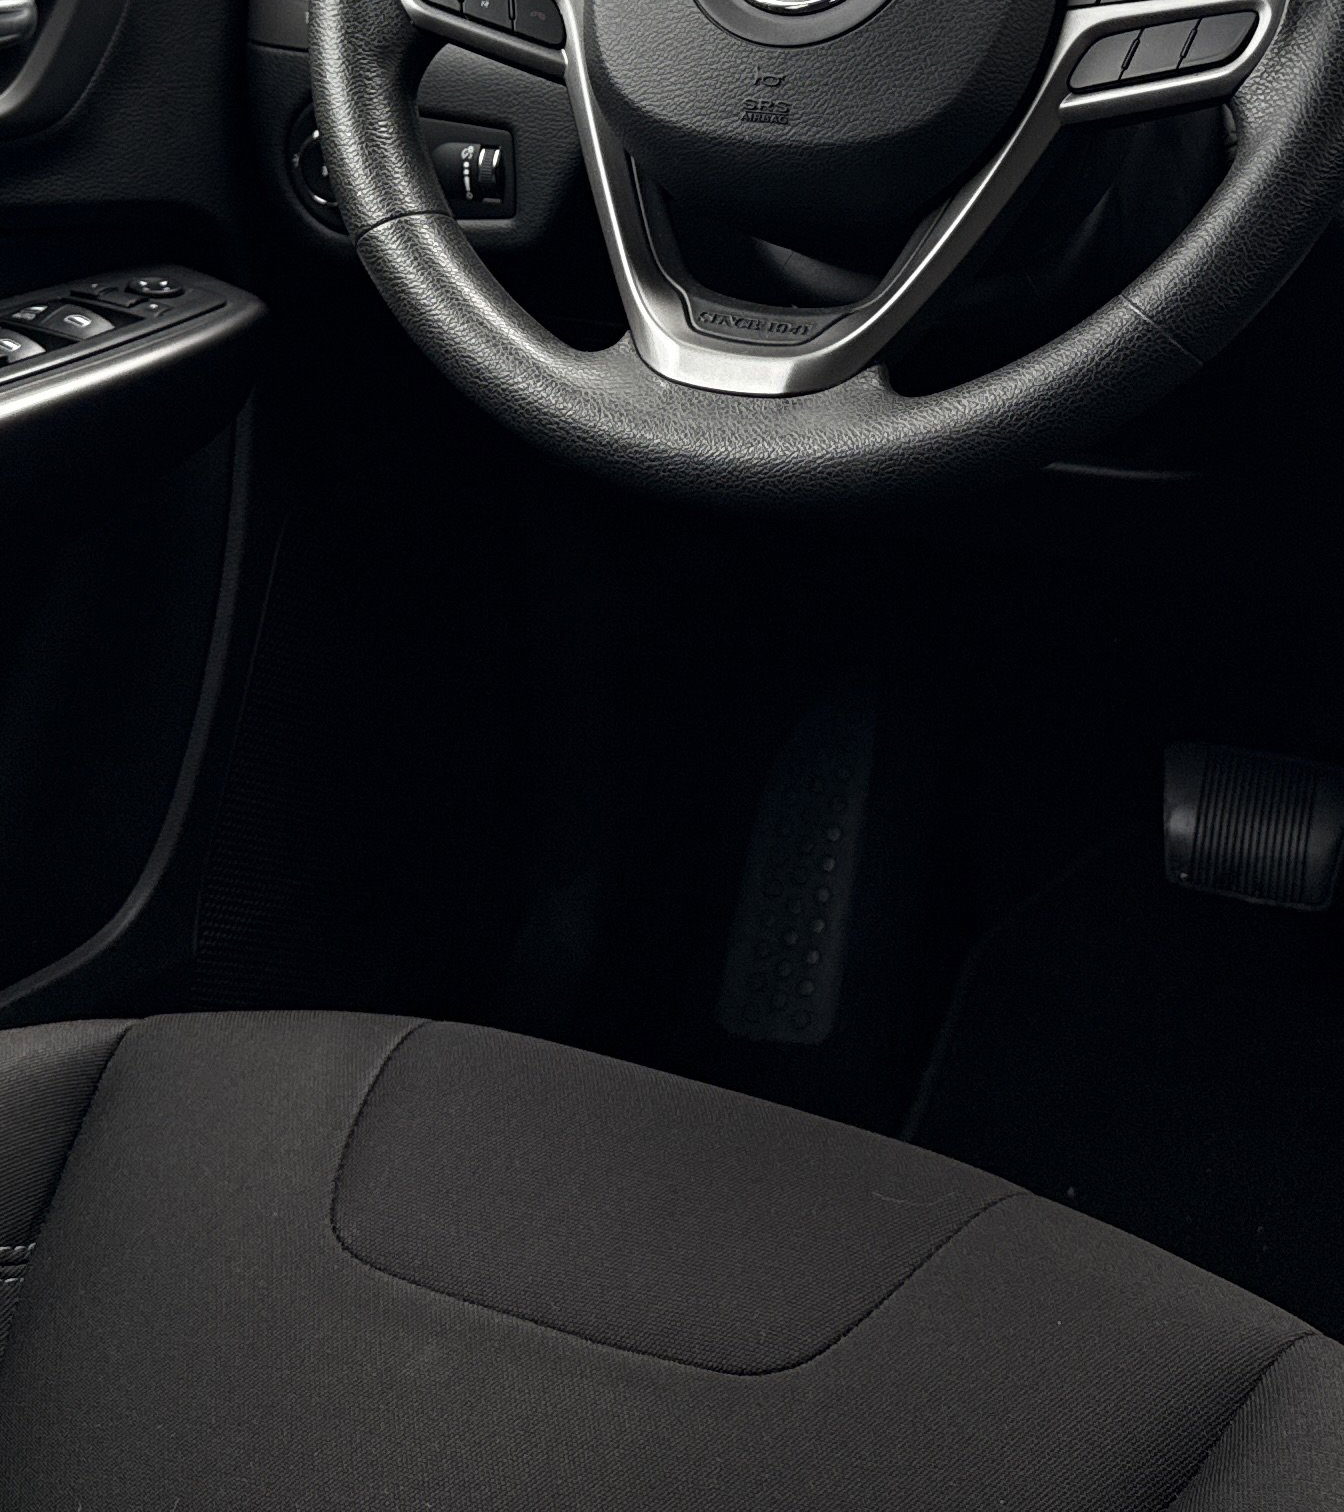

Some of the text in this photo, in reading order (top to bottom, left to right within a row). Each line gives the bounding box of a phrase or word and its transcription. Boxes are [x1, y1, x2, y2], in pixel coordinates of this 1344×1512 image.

[742, 99, 792, 113] SRS
[741, 112, 790, 125] AIRBAG
[698, 311, 761, 331] SINCE
